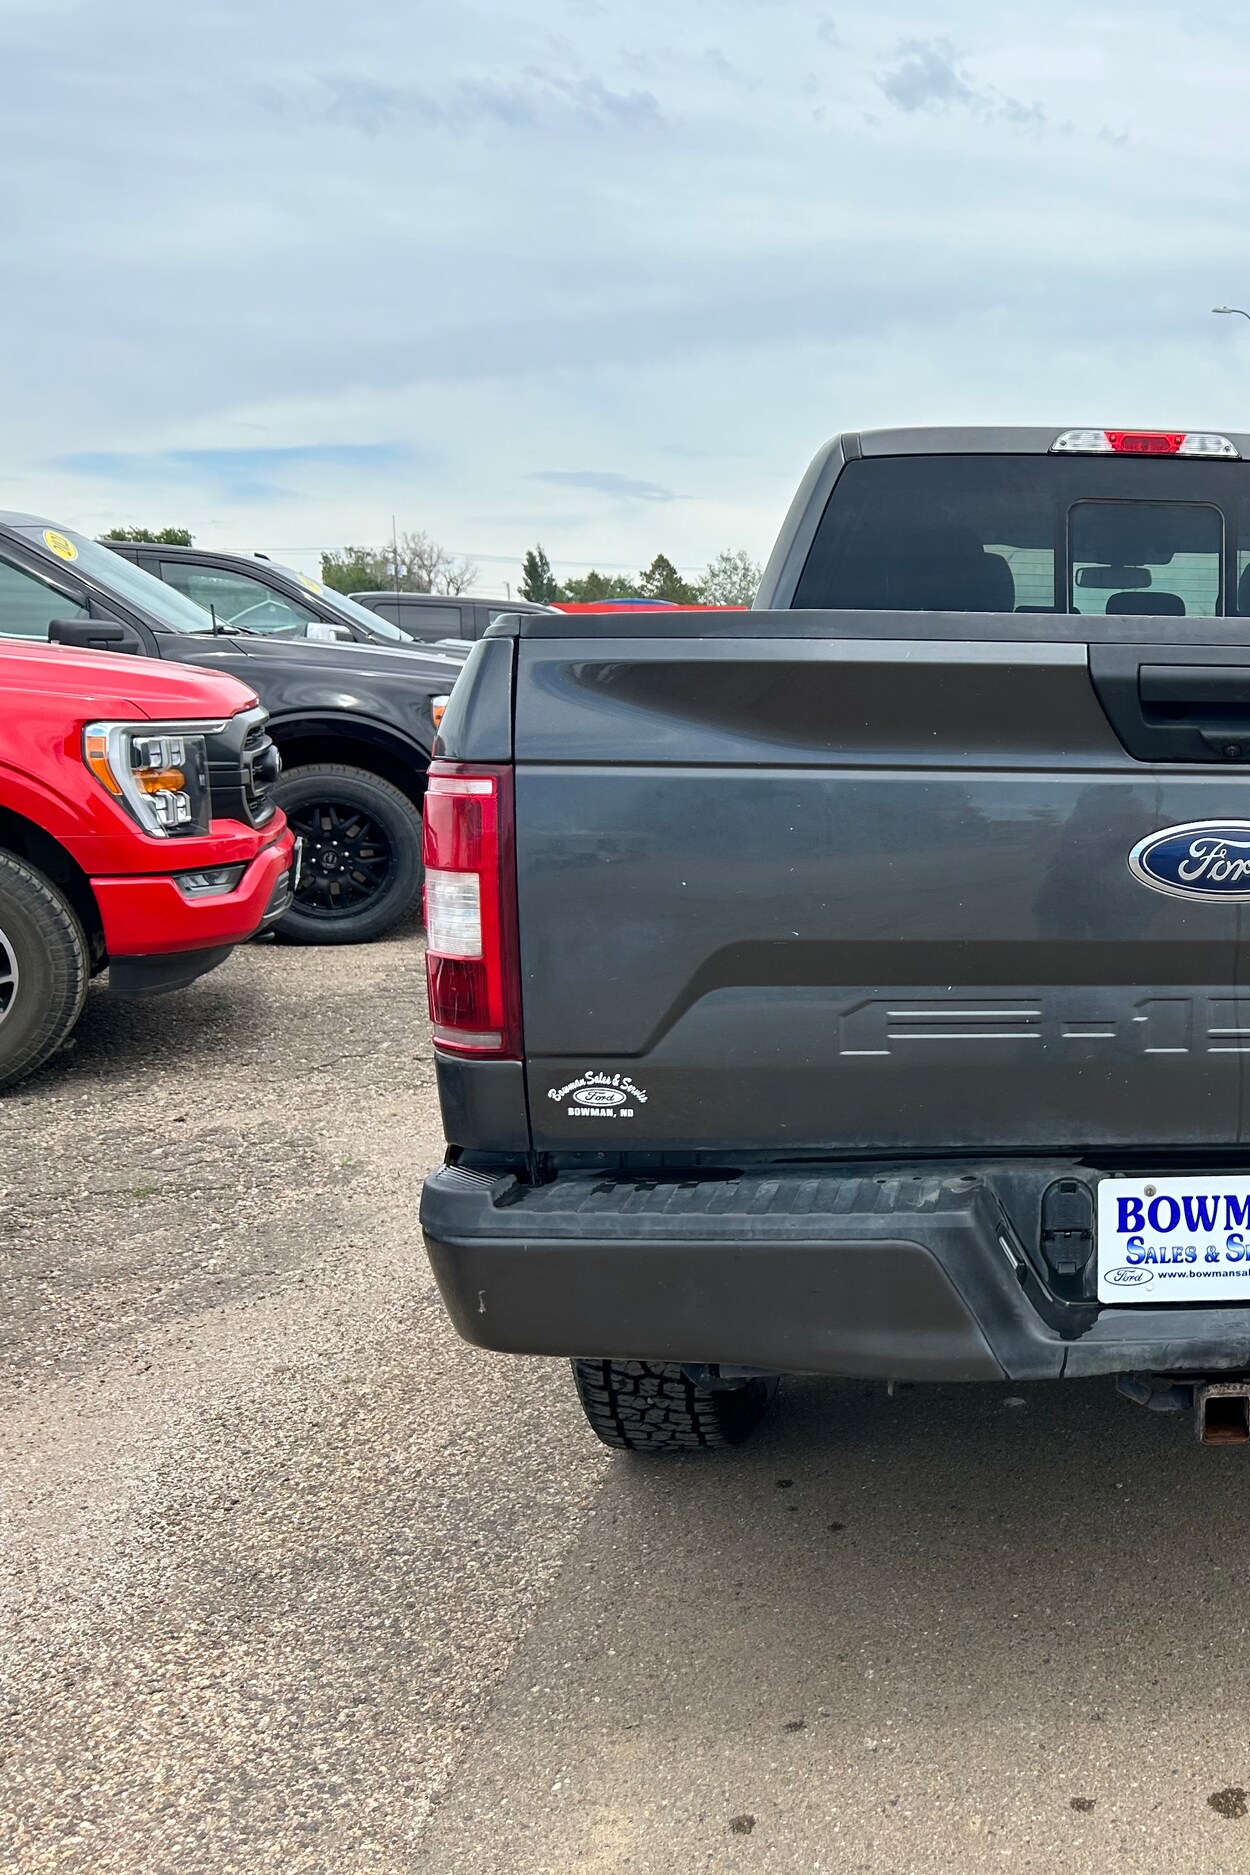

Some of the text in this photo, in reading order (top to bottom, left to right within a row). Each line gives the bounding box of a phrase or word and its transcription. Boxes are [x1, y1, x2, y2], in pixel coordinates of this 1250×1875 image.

[547, 1070, 649, 1103] Bowman Sales & Service
[584, 1091, 616, 1102] Ford
[567, 1107, 634, 1118] BOWMAN, ND
[1203, 1244, 1221, 1264] &
[1113, 1269, 1144, 1283] Ford
